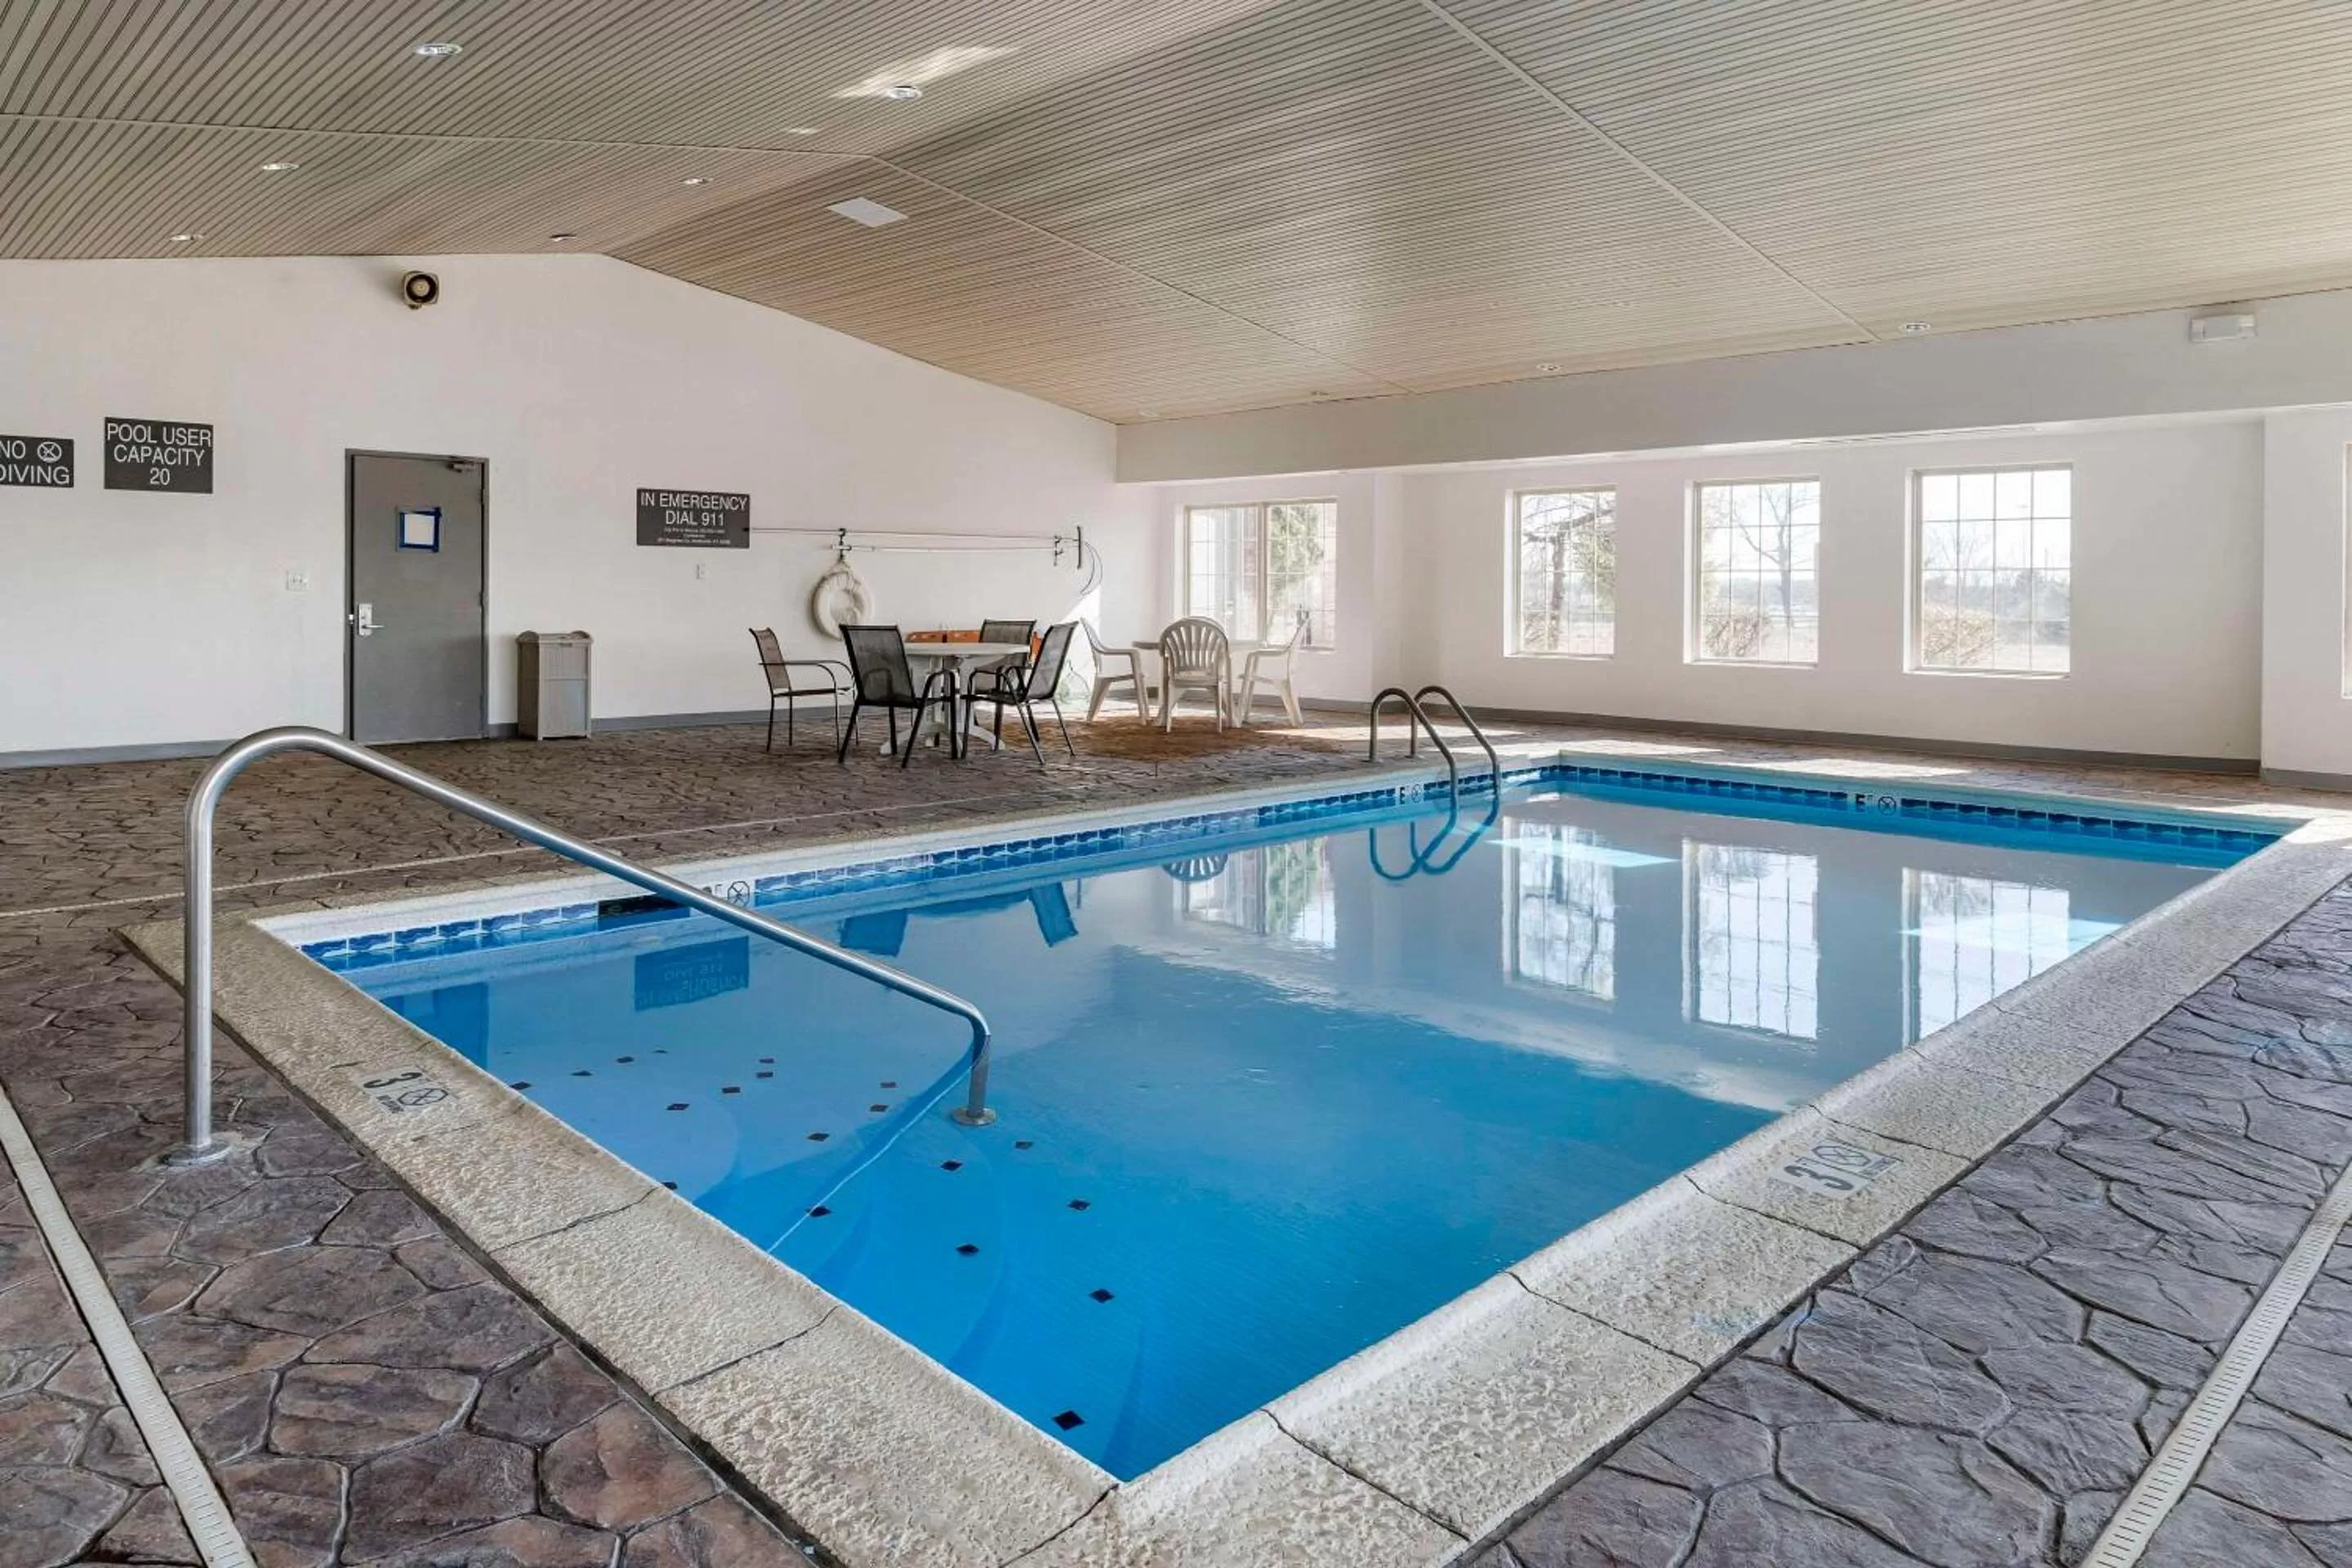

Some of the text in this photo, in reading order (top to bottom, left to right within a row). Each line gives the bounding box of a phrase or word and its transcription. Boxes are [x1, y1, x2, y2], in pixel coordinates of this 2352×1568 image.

[106, 423, 212, 448] POOL USER
[0, 439, 26, 460] NO
[114, 444, 205, 466] CAPACITY
[149, 468, 171, 486] 20
[641, 492, 747, 511] IN EMERGENCY
[666, 510, 724, 527] DIAL 911
[363, 1071, 423, 1089] 3
[1784, 1165, 1855, 1191] 3
